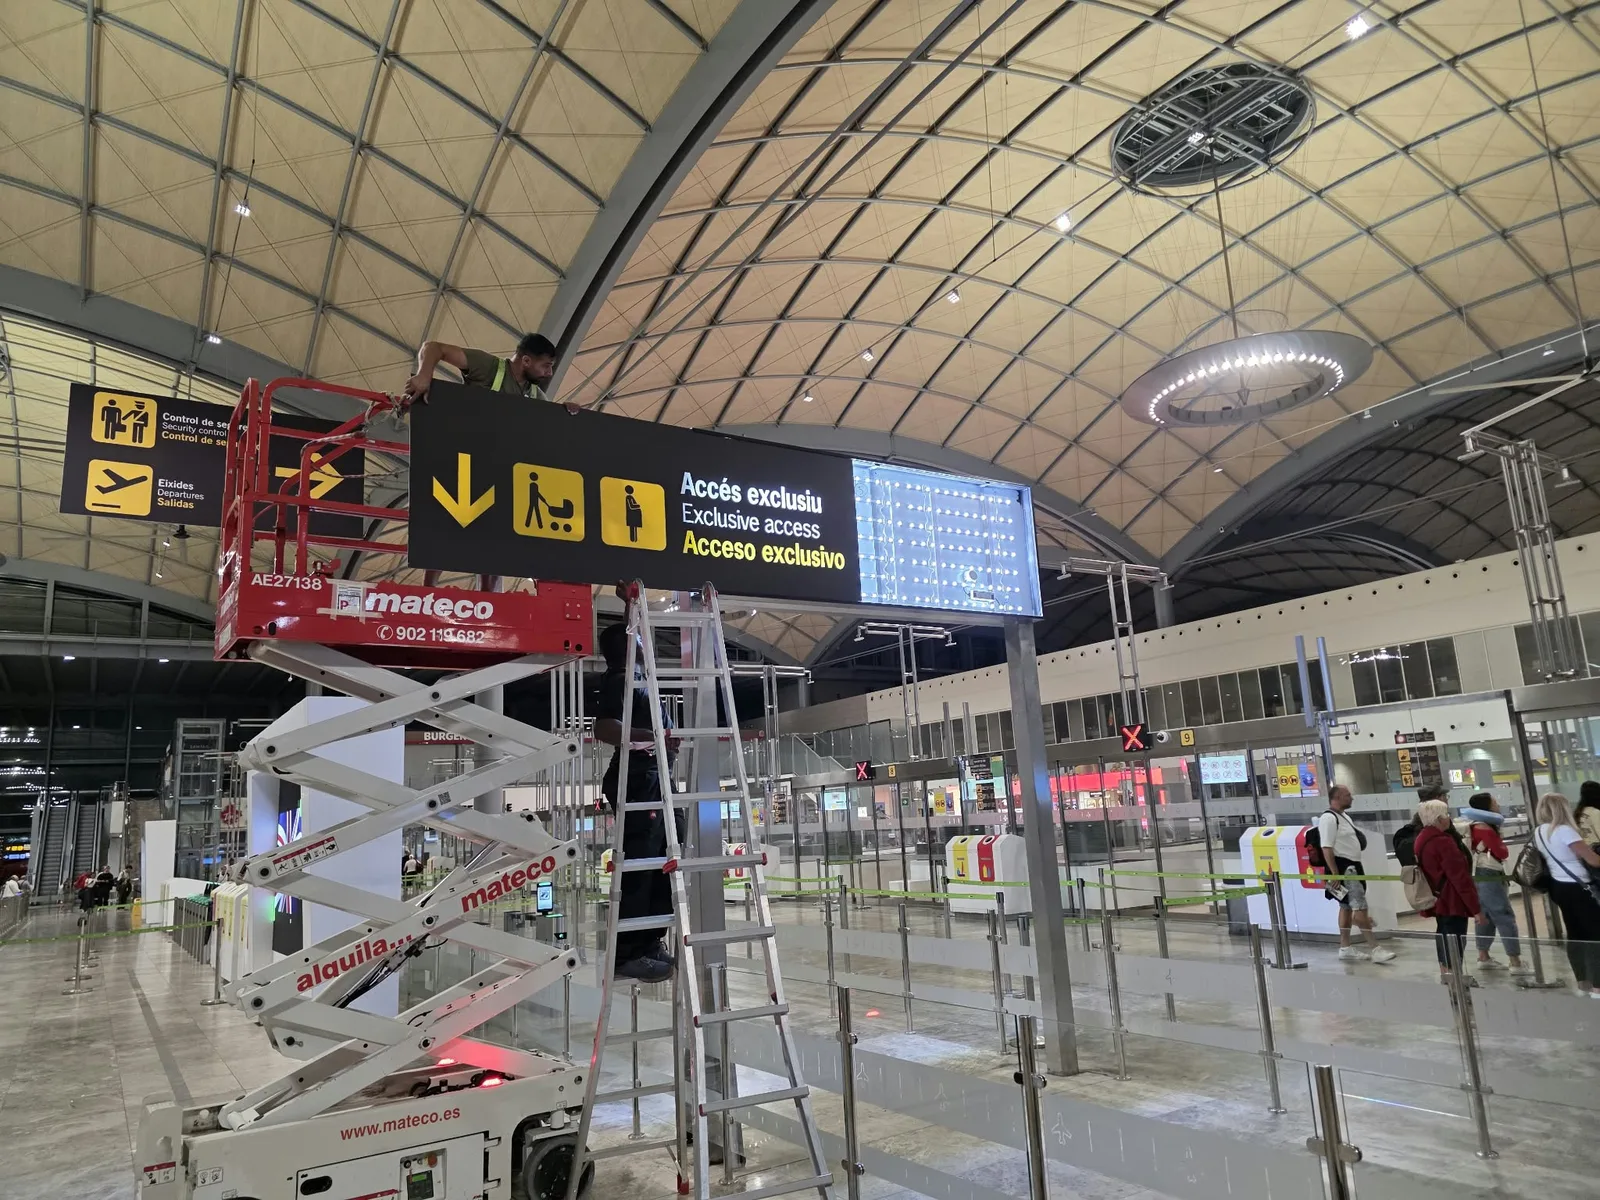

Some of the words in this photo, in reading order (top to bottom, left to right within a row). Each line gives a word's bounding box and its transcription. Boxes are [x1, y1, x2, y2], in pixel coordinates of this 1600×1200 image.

[162, 412, 198, 425] Control
[202, 418, 214, 427] de
[162, 421, 197, 434] Security
[198, 427, 227, 437] control
[161, 430, 197, 443] Control
[200, 436, 213, 445] de
[158, 478, 194, 490] Eixides
[157, 488, 205, 500] Departures
[680, 471, 742, 503] Accés
[747, 485, 822, 514] exclusiu
[157, 497, 195, 509] Salidas
[682, 502, 760, 532] Exclusive
[764, 515, 821, 539] access
[682, 530, 756, 562] Acceso
[763, 542, 846, 571] exclusivo
[251, 574, 322, 590] AE27138
[365, 592, 494, 620] mateco
[396, 627, 426, 641] 902
[429, 628, 453, 642] 119
[456, 630, 485, 643] 682
[1184, 733, 1190, 743] 9
[461, 855, 556, 913] mateco
[340, 1106, 460, 1140] www.mateco.es
